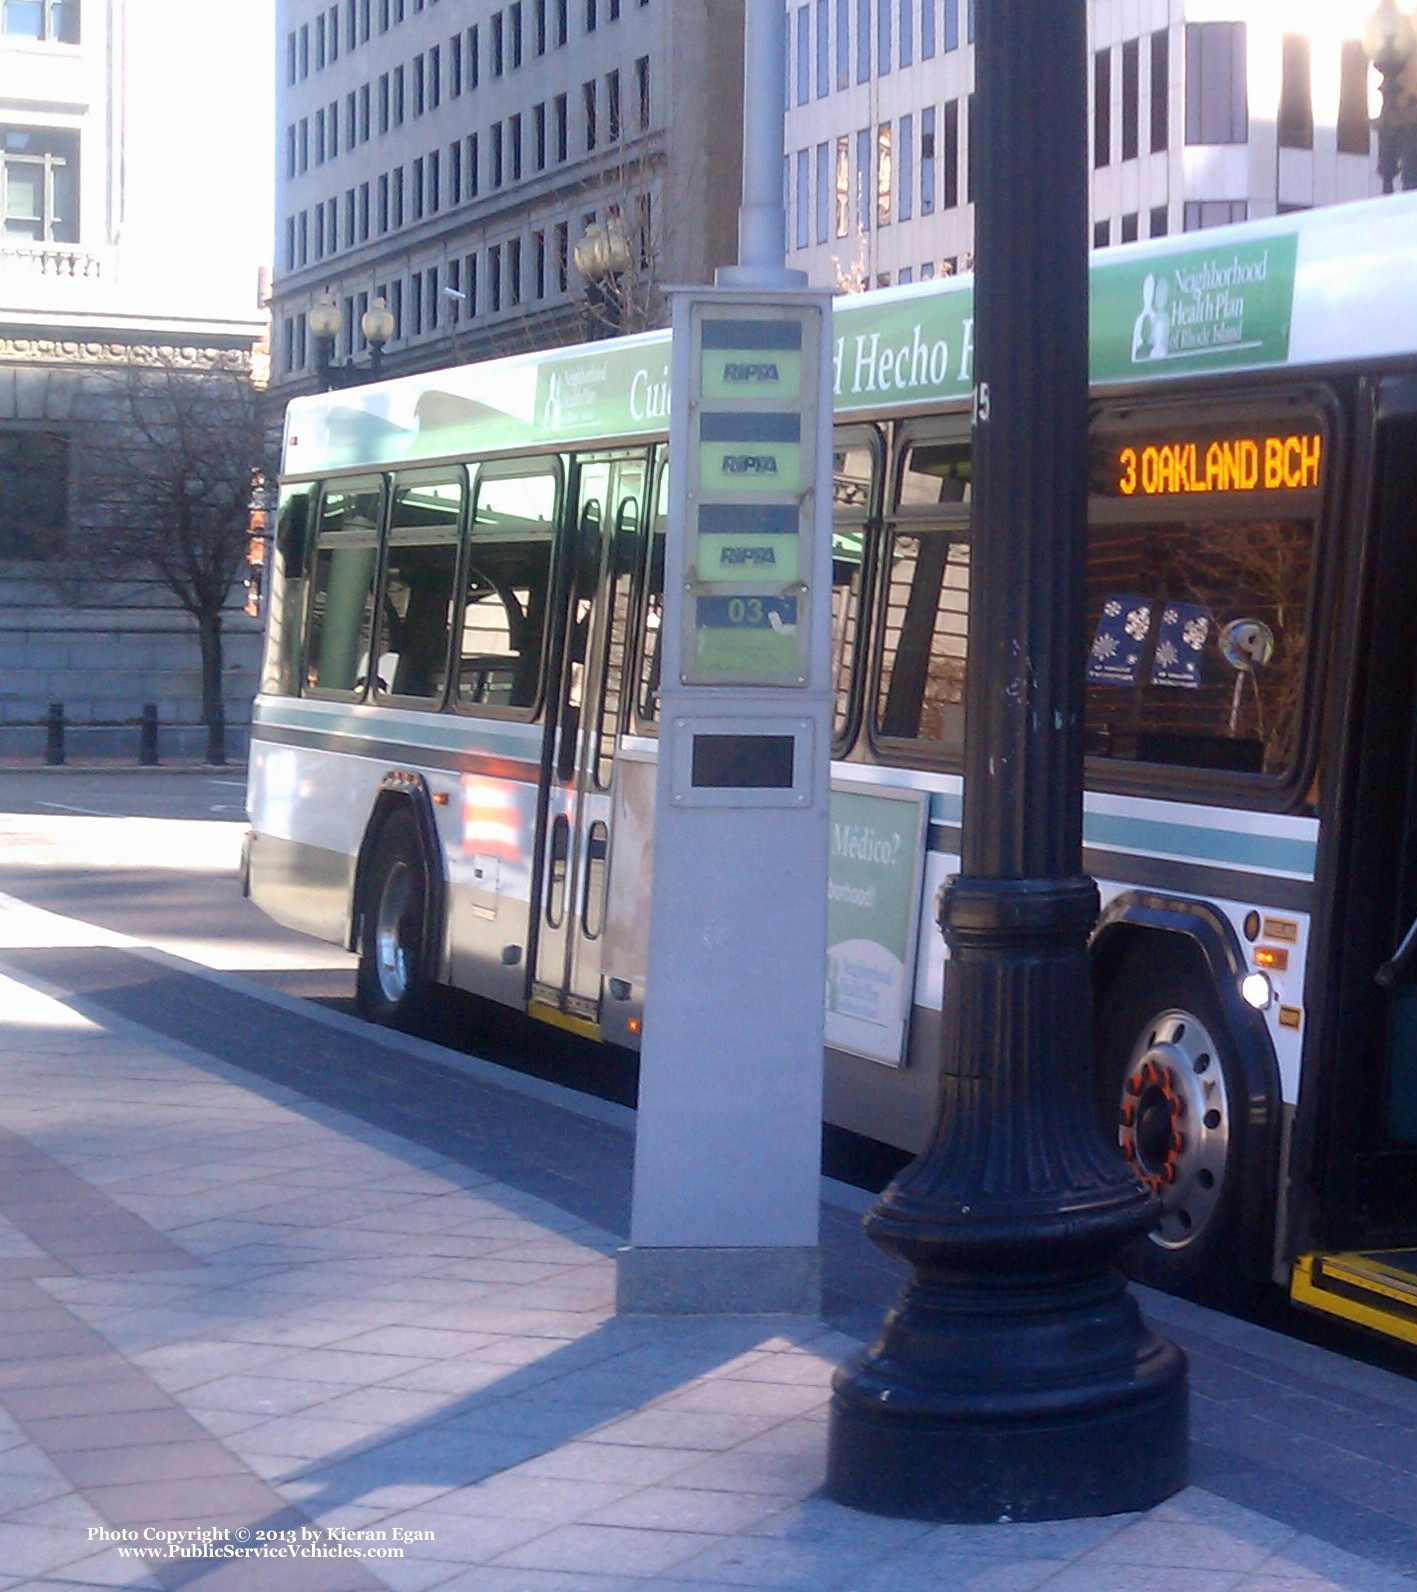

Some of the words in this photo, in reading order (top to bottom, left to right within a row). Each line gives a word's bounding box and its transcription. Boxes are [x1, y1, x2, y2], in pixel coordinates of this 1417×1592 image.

[1175, 249, 1268, 300] Neighborhood
[1171, 294, 1213, 326] Health
[1215, 290, 1244, 320] Plan
[723, 363, 779, 382] RIPTA
[851, 323, 949, 394] Hecho
[721, 455, 777, 474] RIPTA
[1120, 447, 1137, 495] 3
[1142, 440, 1258, 494] OAKLAND
[1264, 434, 1322, 488] BCH
[720, 546, 776, 565] RIPTA
[728, 599, 763, 623] 03
